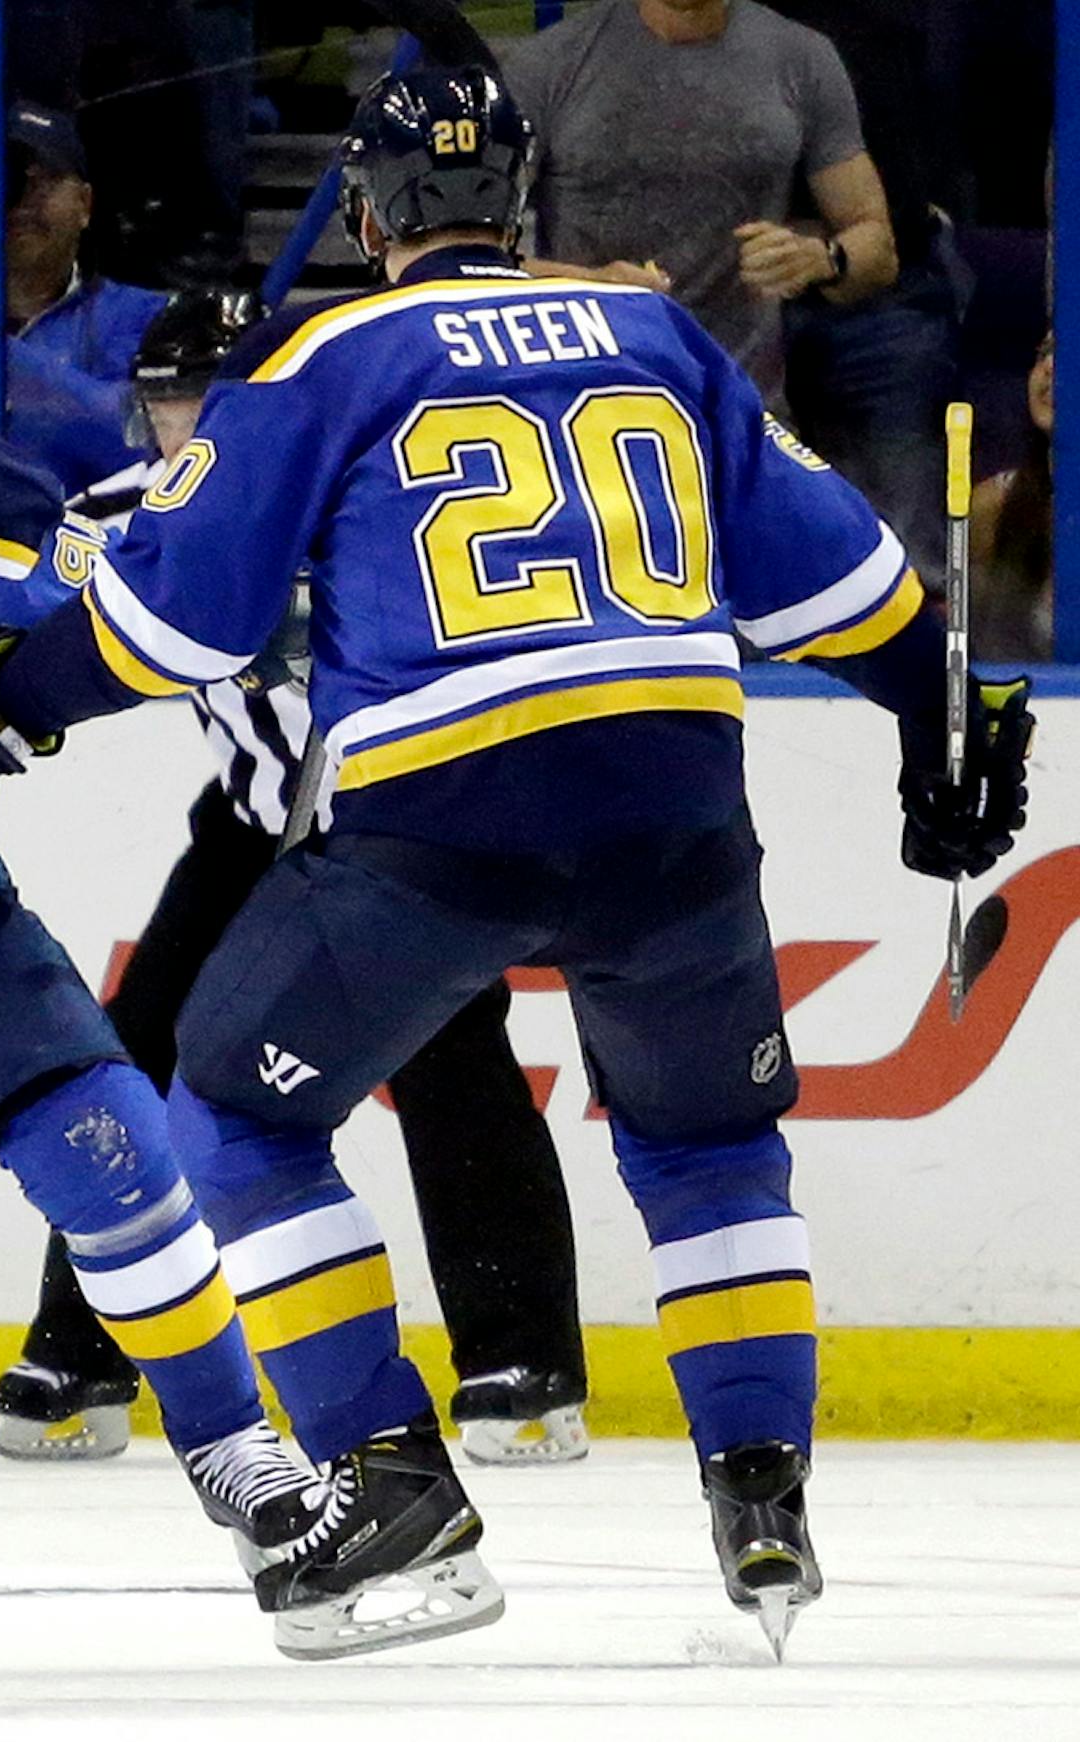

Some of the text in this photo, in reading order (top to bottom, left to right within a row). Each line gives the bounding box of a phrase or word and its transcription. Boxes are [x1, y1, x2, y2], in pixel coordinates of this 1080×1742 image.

[431, 118, 478, 155] 20
[432, 299, 620, 368] STEEN
[392, 384, 719, 650] 20
